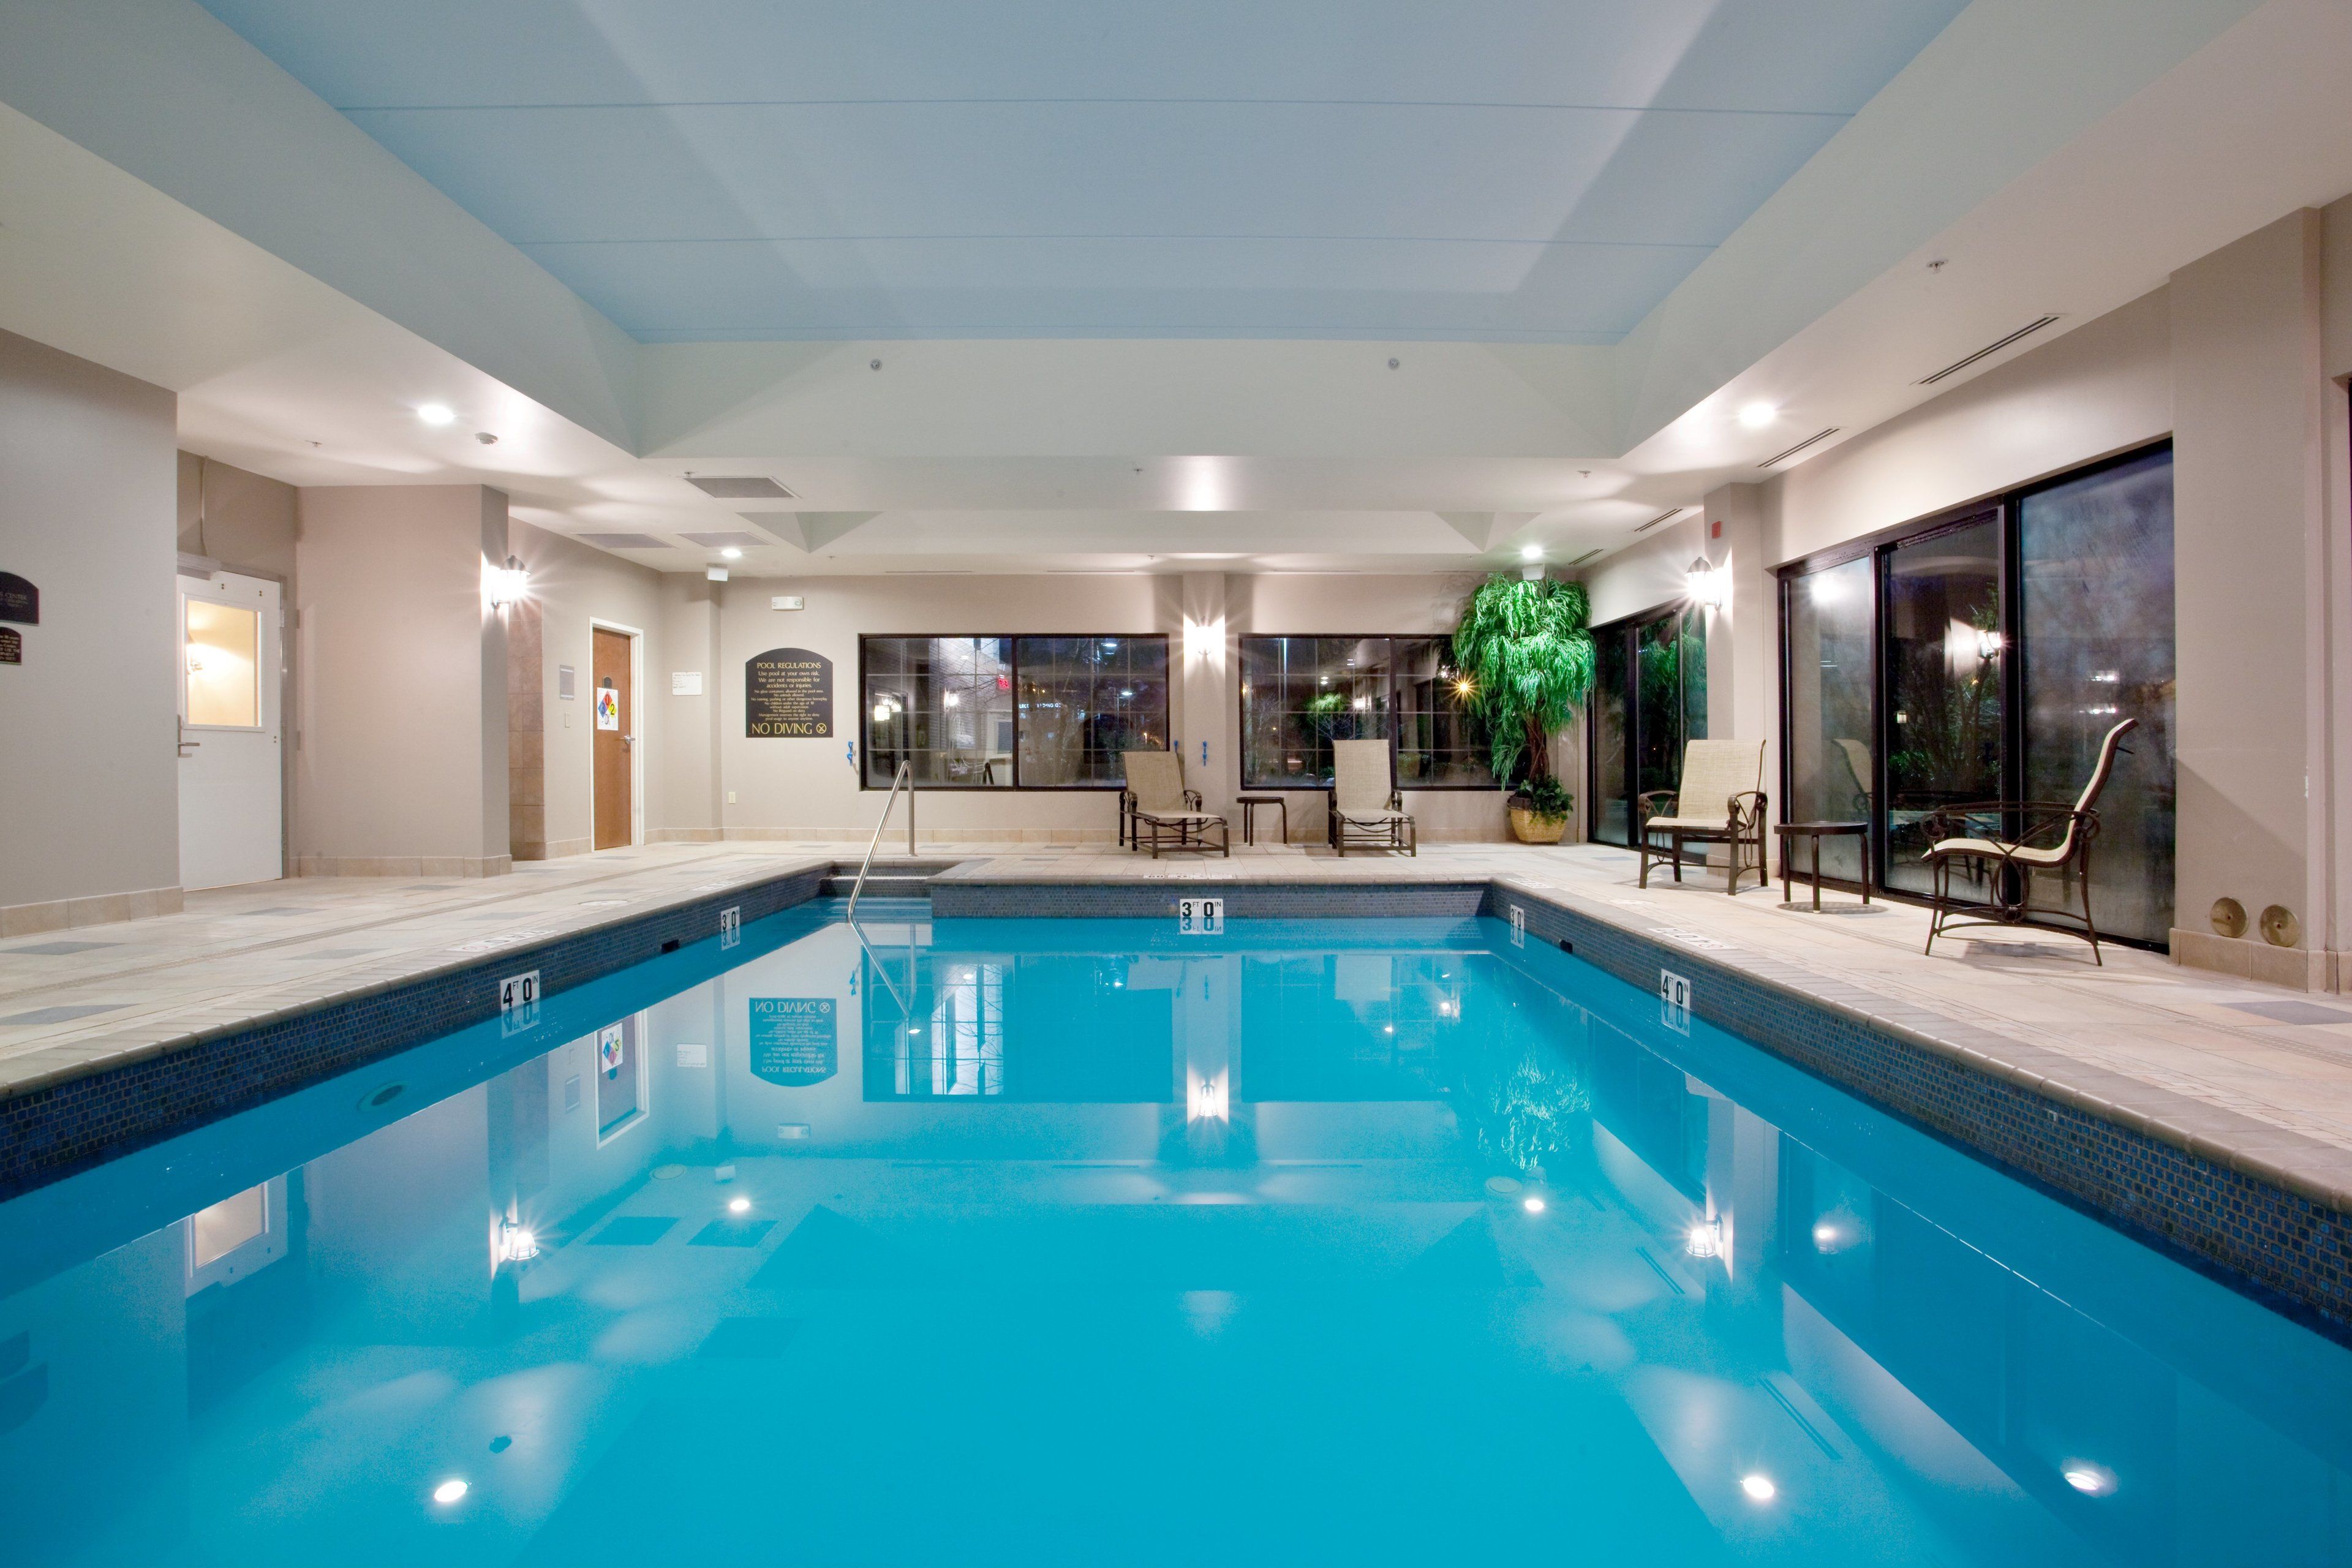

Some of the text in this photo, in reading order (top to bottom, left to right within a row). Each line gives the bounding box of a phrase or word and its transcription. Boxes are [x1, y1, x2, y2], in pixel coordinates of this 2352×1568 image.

[611, 703, 615, 715] 2
[752, 723, 813, 734] NO DIVING
[1182, 902, 1192, 917] 3
[1204, 902, 1214, 917] 0
[1511, 908, 1515, 924] 3
[1517, 911, 1521, 927] 0
[722, 914, 727, 931] 3
[731, 911, 736, 927] 0
[503, 975, 538, 1007] 4 FT 0 IN
[1662, 975, 1669, 998] 4
[1669, 976, 1674, 986] FT
[1676, 981, 1683, 1005] 0
